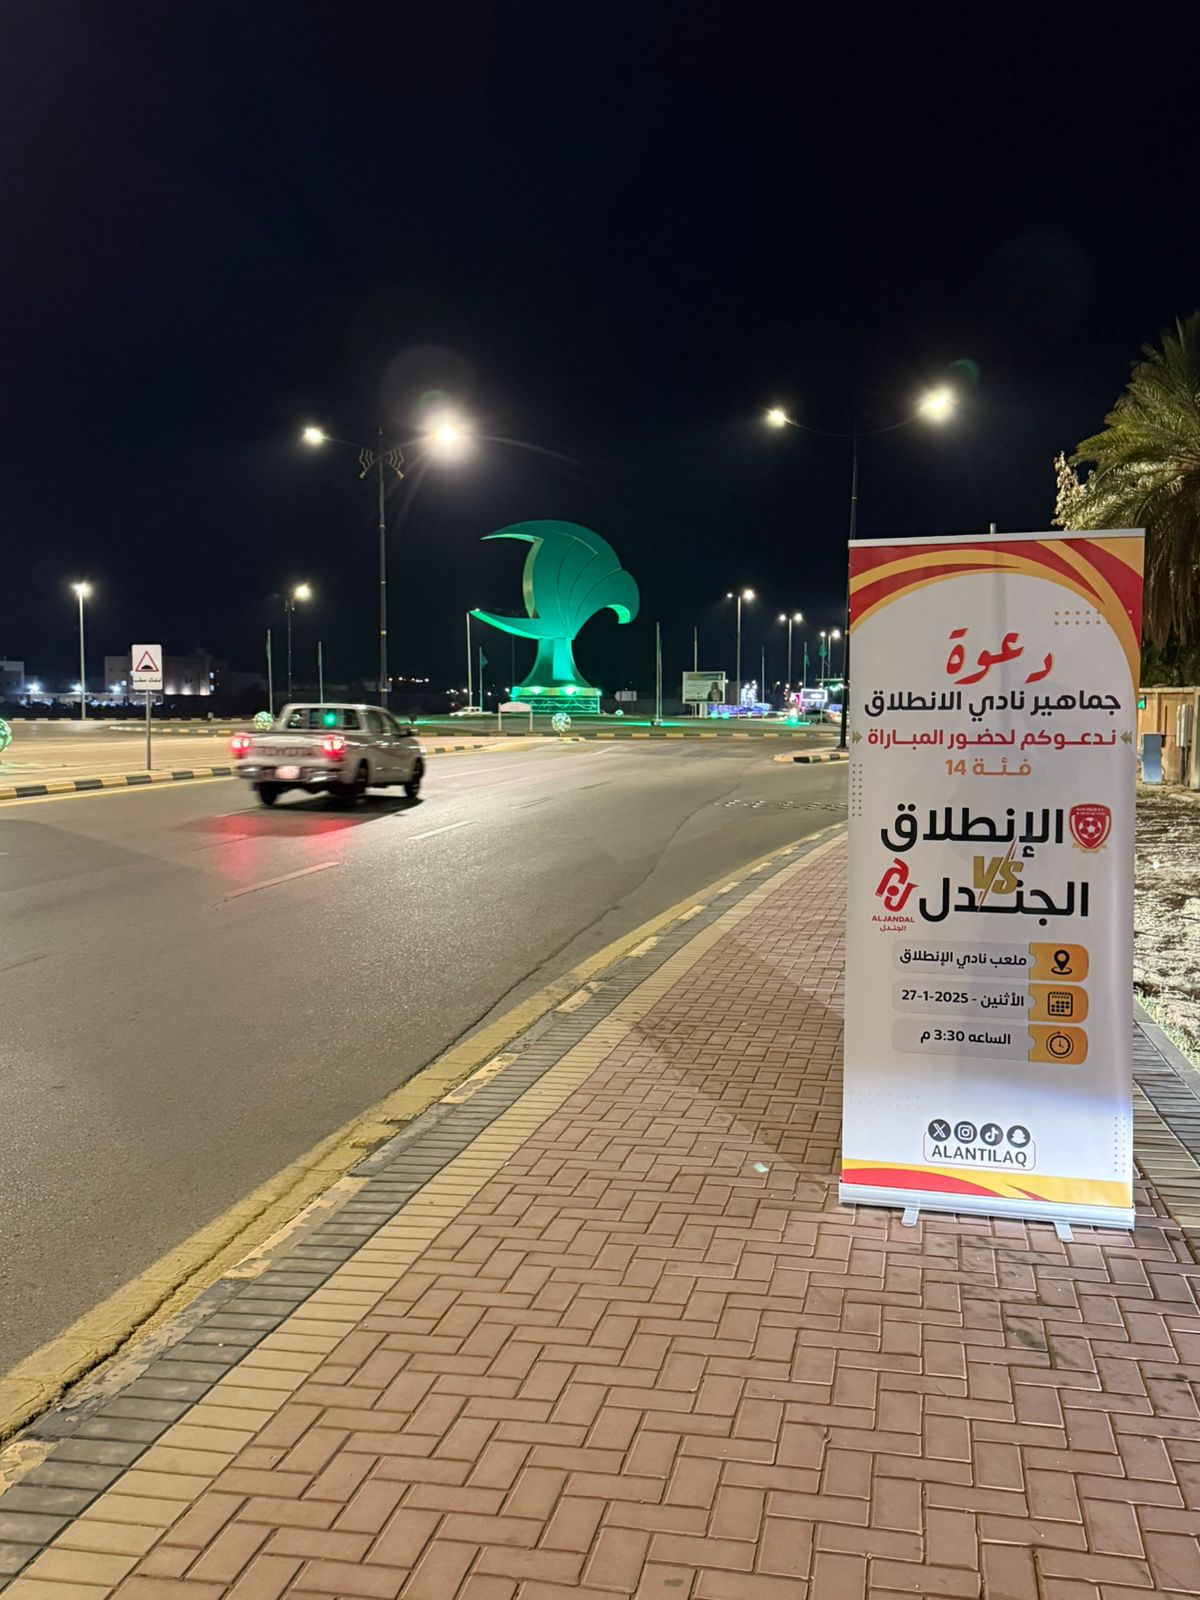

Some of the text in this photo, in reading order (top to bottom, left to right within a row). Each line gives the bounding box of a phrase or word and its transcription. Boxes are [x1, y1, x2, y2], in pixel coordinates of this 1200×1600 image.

[946, 627, 1055, 686] دعوة
[864, 690, 1122, 723] جماهير نادي الانطلاق
[866, 728, 1117, 752] ندعوكم لحضور المباراة
[945, 756, 1032, 777] فئة 14
[880, 803, 1064, 858] الإنطلاق
[973, 854, 1025, 895] VS
[918, 876, 1090, 927] الجندل
[871, 915, 915, 923] ALJANDAL
[879, 924, 907, 933] الجندل
[899, 948, 1027, 970] ملعب نادي الإنطلاق
[901, 988, 969, 1004] 27-1-2025
[980, 991, 1025, 1009] الأثنين
[920, 1029, 1011, 1045] الساعه 3:30 م
[931, 1144, 1028, 1168] ALANTILAQ
